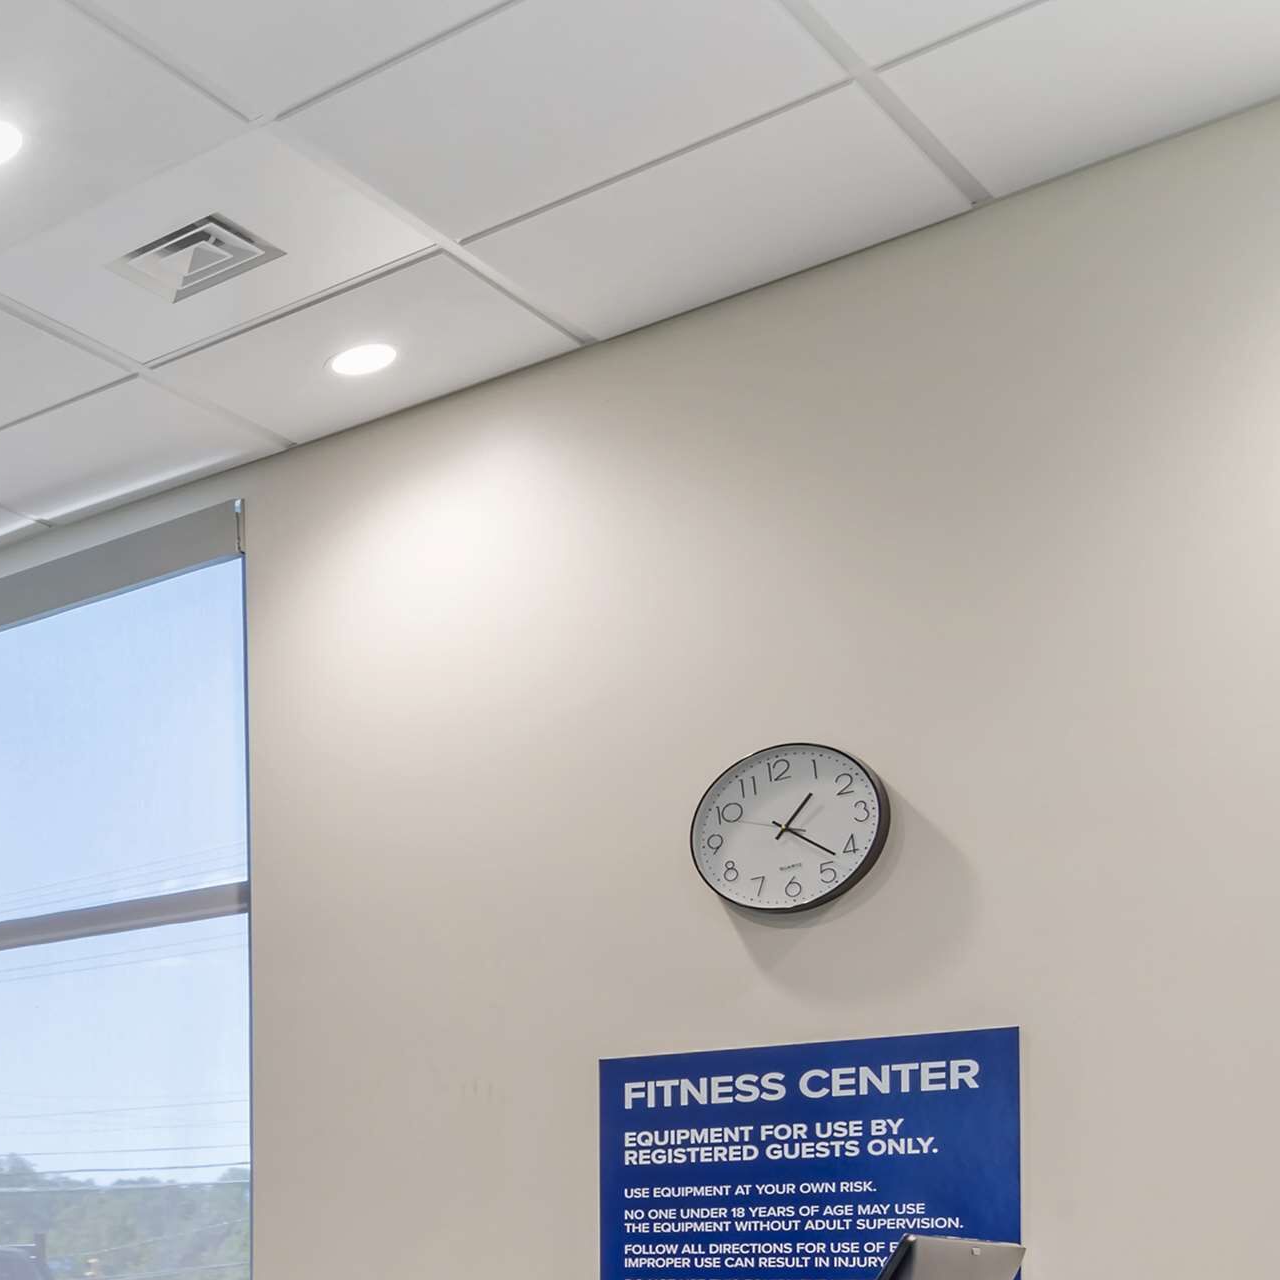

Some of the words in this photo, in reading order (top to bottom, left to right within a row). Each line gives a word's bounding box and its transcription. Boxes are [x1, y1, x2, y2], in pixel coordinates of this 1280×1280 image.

[767, 759, 791, 782] 12
[812, 759, 818, 779] 1
[740, 776, 757, 798] 11
[835, 773, 854, 796] 2
[716, 802, 743, 825] 10
[854, 800, 870, 822] 3
[707, 834, 723, 855] 9
[843, 833, 859, 854] 4
[723, 860, 738, 882] 8
[819, 861, 837, 883] 5
[750, 876, 765, 896] 7
[784, 876, 802, 897] 6
[624, 1072, 786, 1109] FITNESS
[799, 1059, 980, 1098] CENTER
[624, 1126, 753, 1147] EQUIPMENT
[760, 1123, 808, 1141] FOR
[815, 1121, 863, 1138] USE
[871, 1118, 904, 1135] BY
[624, 1145, 759, 1165] REGISTERED
[765, 1140, 860, 1159] GUESTS
[867, 1137, 938, 1156] ONLY.
[624, 1188, 649, 1198] USE
[653, 1185, 731, 1197] EQUIPMENT
[735, 1184, 752, 1196] AT
[755, 1183, 795, 1195] YOUR
[799, 1182, 836, 1194] OWN
[840, 1181, 877, 1192] RISK.
[624, 1209, 644, 1220] NO
[648, 1209, 677, 1219] ONE
[680, 1208, 727, 1219] UNDER
[731, 1207, 745, 1218] 18
[749, 1206, 795, 1217] YEARS
[799, 1206, 820, 1217] OF
[823, 1205, 854, 1216] AGE
[858, 1204, 890, 1215] MAY
[895, 1204, 926, 1215] USE
[624, 1222, 649, 1233] THE
[653, 1221, 731, 1233] EQUIPMENT
[734, 1220, 801, 1232] WITHOUT
[804, 1219, 852, 1230] ADULT
[856, 1217, 964, 1230] SUPERVISION.
[624, 1244, 678, 1255] FOLLOW
[681, 1244, 705, 1255] ALL
[709, 1243, 793, 1254] DIRECTIONS
[797, 1242, 826, 1253] FOR
[830, 1242, 860, 1253] USE
[864, 1242, 886, 1253] OF
[624, 1257, 690, 1268] IMPROPER
[694, 1257, 721, 1268] USE
[724, 1257, 755, 1268] CAN
[758, 1257, 812, 1268] RESULT
[814, 1257, 830, 1268] IN
